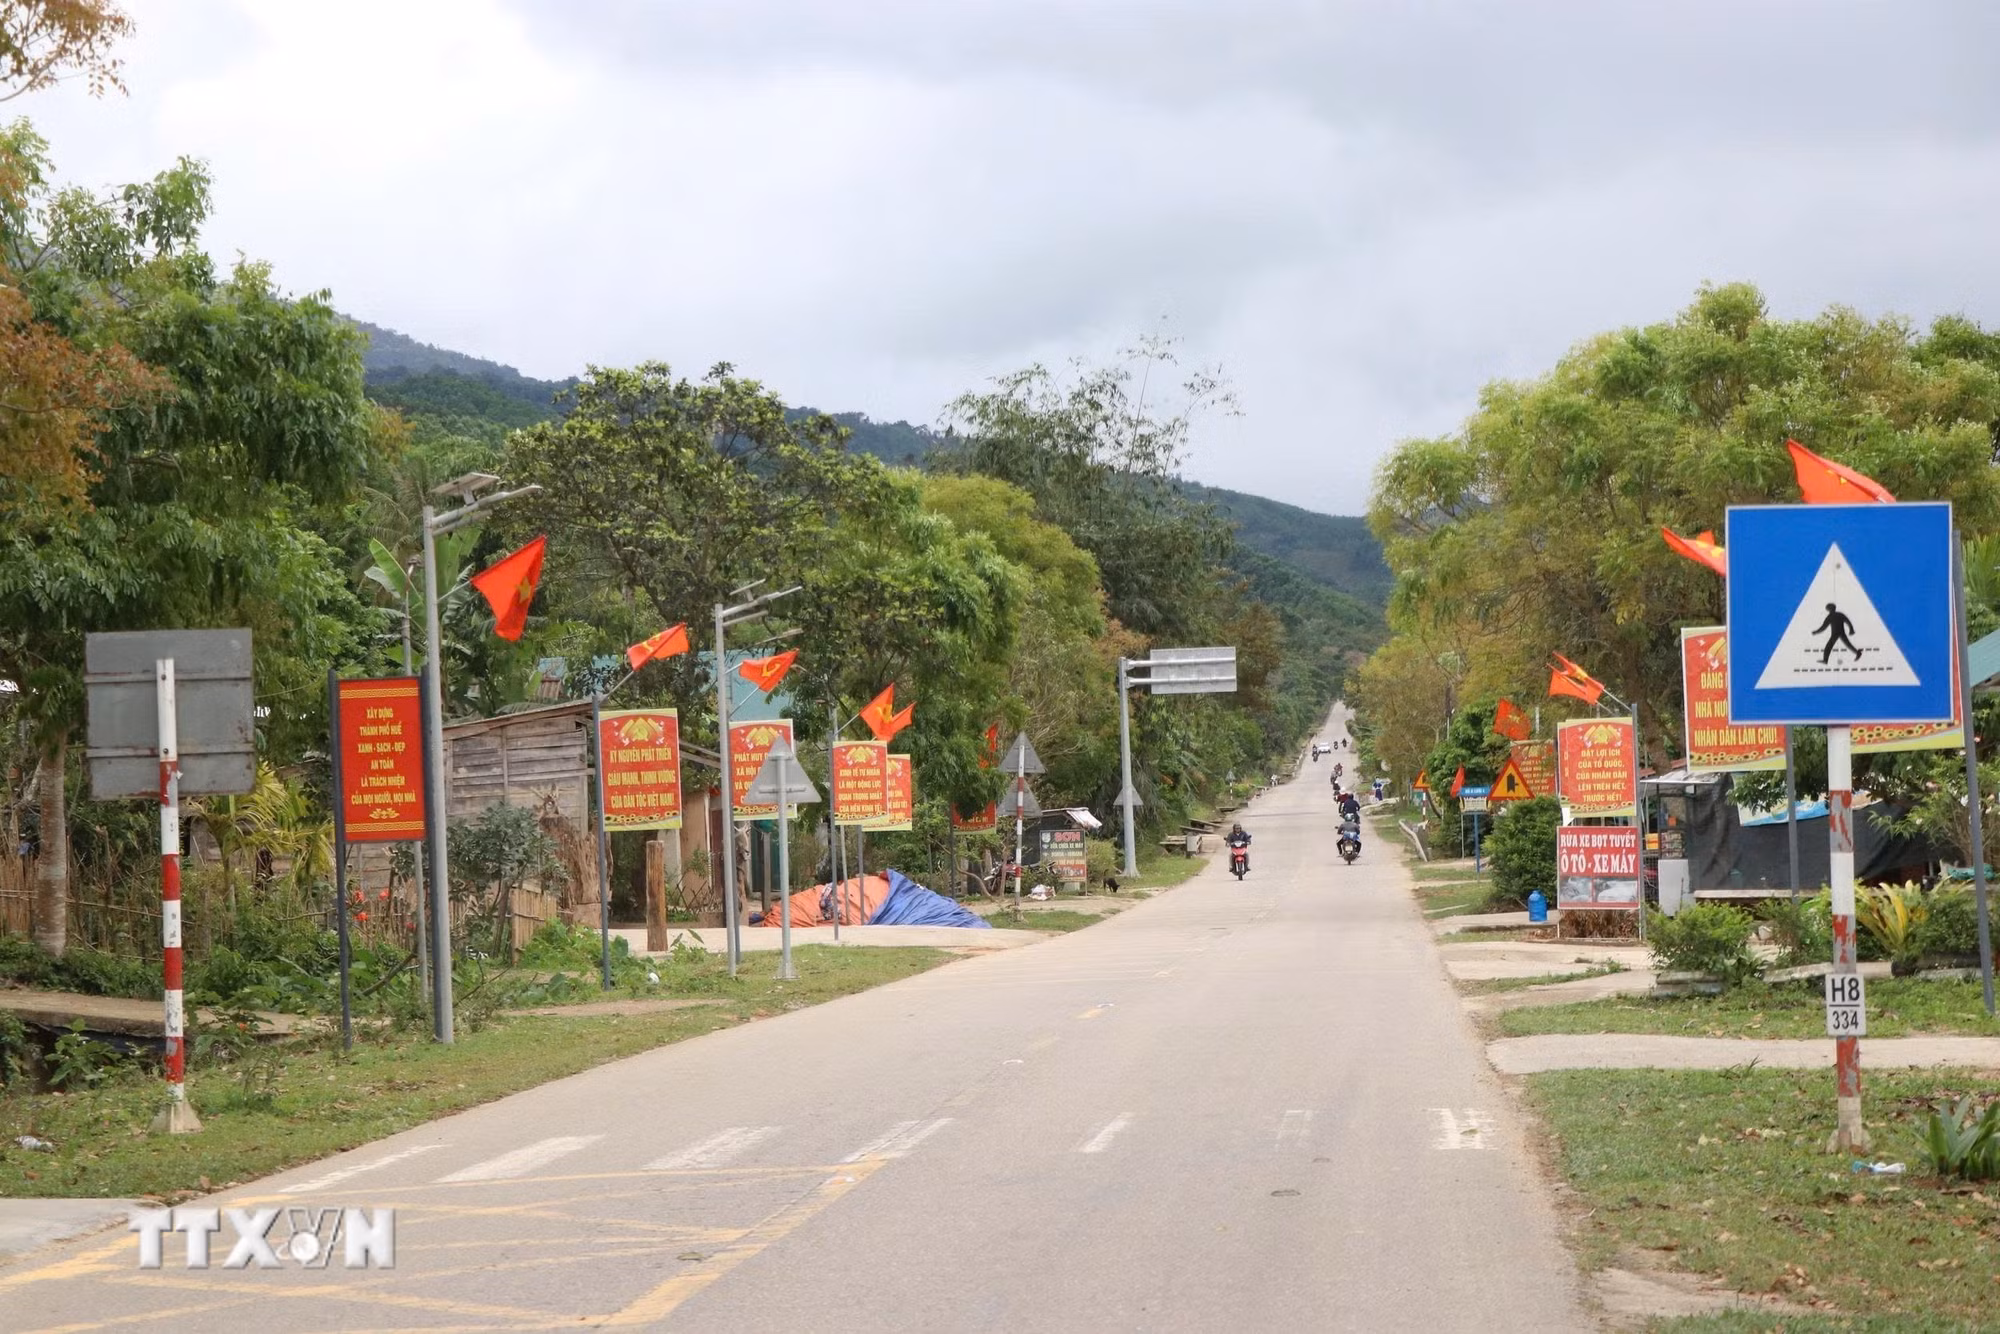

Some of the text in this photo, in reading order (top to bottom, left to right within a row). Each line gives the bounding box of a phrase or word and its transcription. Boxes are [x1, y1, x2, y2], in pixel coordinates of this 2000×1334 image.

[1701, 668, 1723, 689] ĐẢNG
[367, 707, 393, 721] XÂY DỰNG
[1695, 698, 1712, 718] NHÀ
[360, 721, 402, 736] THÀNH PHỐ HUẾ
[1695, 726, 1717, 746] NHÂN
[1720, 726, 1736, 745] DÂN
[1738, 725, 1756, 744] LÀM
[358, 743, 372, 753] XANH
[376, 742, 391, 755] SẠCH
[395, 742, 406, 754] ĐẸP
[618, 746, 640, 762] NGUYÊN
[641, 746, 655, 762] PHÁT
[656, 743, 671, 760] TRIỂN
[1609, 748, 1620, 757] ÍCH
[371, 757, 394, 769] AN TOÀN
[734, 753, 750, 762] PHÁT
[752, 753, 763, 761] HUY
[1578, 759, 1592, 768] CỦA
[1594, 758, 1602, 768] TỔ
[746, 765, 756, 776] HỘI
[840, 768, 851, 776] KINH
[853, 767, 858, 776] TẾ
[867, 767, 880, 776] NHÂN
[1576, 771, 1590, 780] CỦA
[1592, 771, 1611, 779] NHÂN
[361, 774, 405, 788] LÀ TRÁCH NHIỆM
[608, 770, 620, 786] GIÀU
[641, 771, 657, 787] THỊNH
[658, 769, 676, 786] VƯỢNG
[839, 780, 845, 789] LÀ
[846, 780, 856, 789] MỘT
[872, 780, 881, 789] LỰC
[735, 781, 743, 790] VÀ
[1578, 783, 1591, 791] LÊN
[351, 790, 362, 805] CỦA
[363, 794, 373, 806] MỌI
[394, 792, 403, 806] MỌI
[404, 789, 416, 802] NHÀ
[611, 791, 622, 808] CỦA
[623, 792, 635, 808] DÂN
[636, 791, 646, 810] TỘC
[647, 791, 658, 809] VIỆT
[853, 792, 868, 800] TRỌNG
[870, 790, 882, 800] NHẤT
[1583, 794, 1605, 802] TRƯỚC
[840, 804, 849, 812] CỦA
[1560, 830, 1635, 849] RỬA XE BỌT TUYẾT
[1561, 848, 1569, 872] Ô
[1571, 848, 1586, 872] TÔ
[1593, 854, 1609, 873] XE
[1610, 848, 1636, 873] MÁY
[1832, 977, 1860, 1002] H8
[1833, 1011, 1859, 1029] 334
